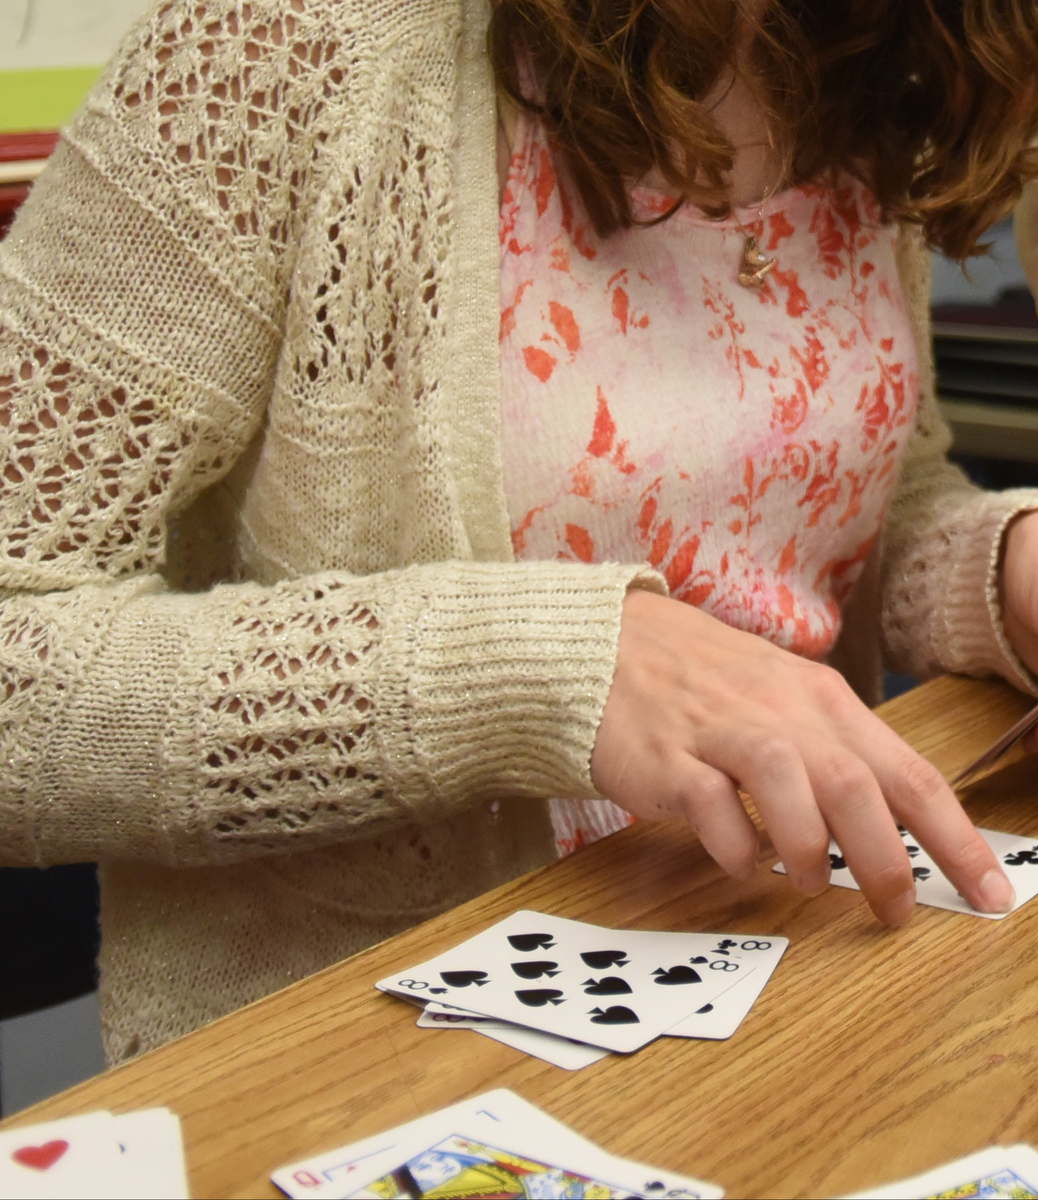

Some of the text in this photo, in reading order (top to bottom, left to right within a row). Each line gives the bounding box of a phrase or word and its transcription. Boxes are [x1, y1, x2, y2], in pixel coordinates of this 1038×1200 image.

[740, 940, 772, 951] 8
[708, 960, 740, 972] 8
[398, 979, 430, 990] 8
